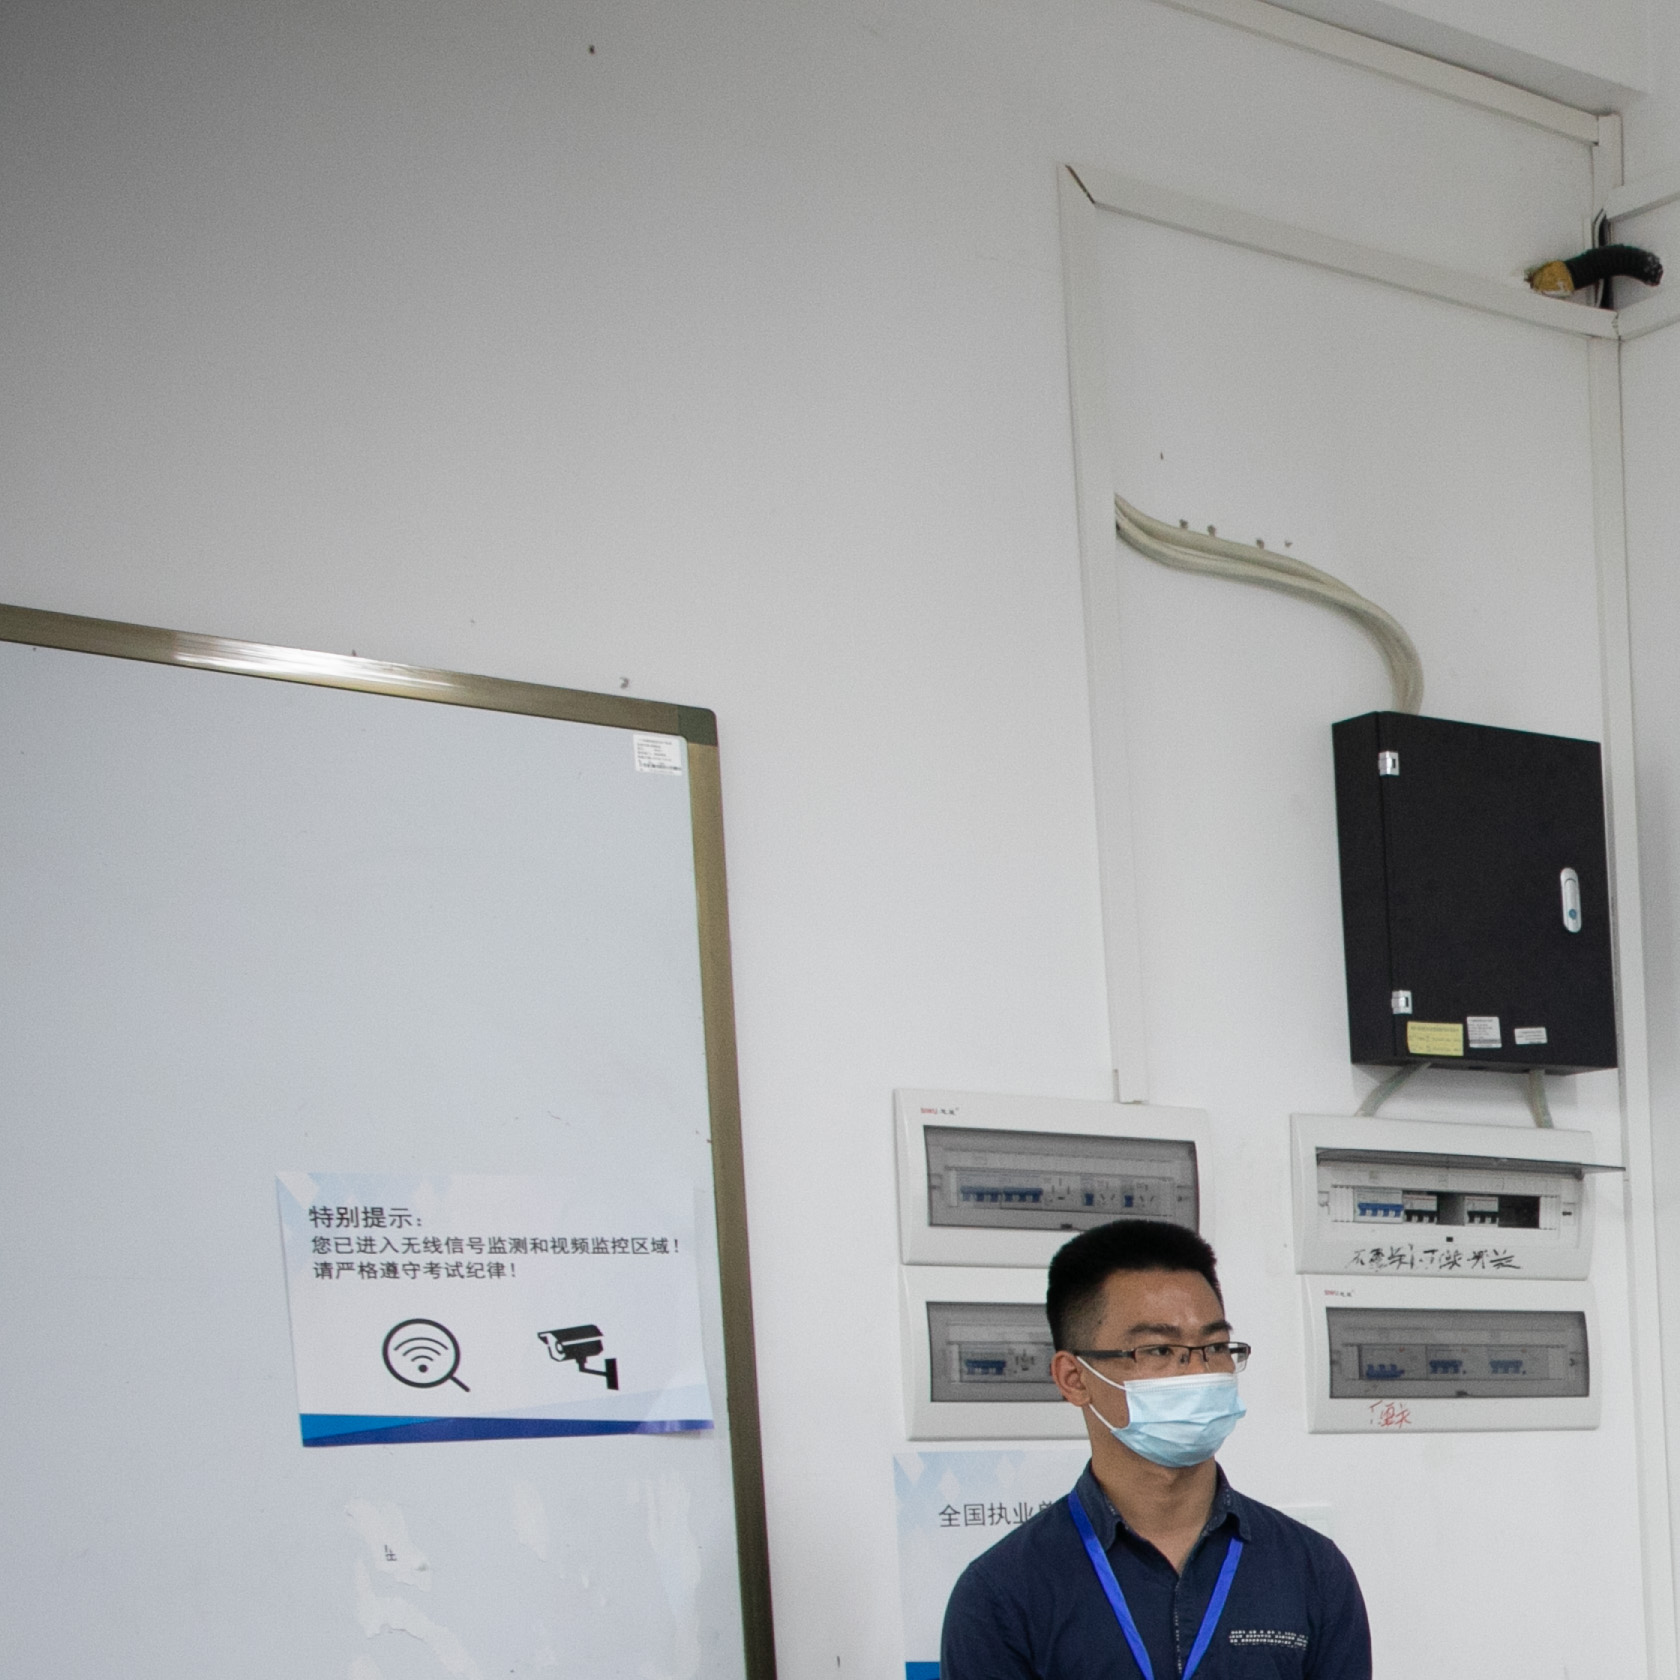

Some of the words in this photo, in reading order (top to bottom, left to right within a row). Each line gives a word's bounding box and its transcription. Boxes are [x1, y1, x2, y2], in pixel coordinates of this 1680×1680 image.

[308, 1206, 423, 1229] 特别提示：
[311, 1235, 681, 1256] 您已进入无线信号监测和视频监控区域！
[313, 1261, 518, 1280] 请严格遵守考试纪律！
